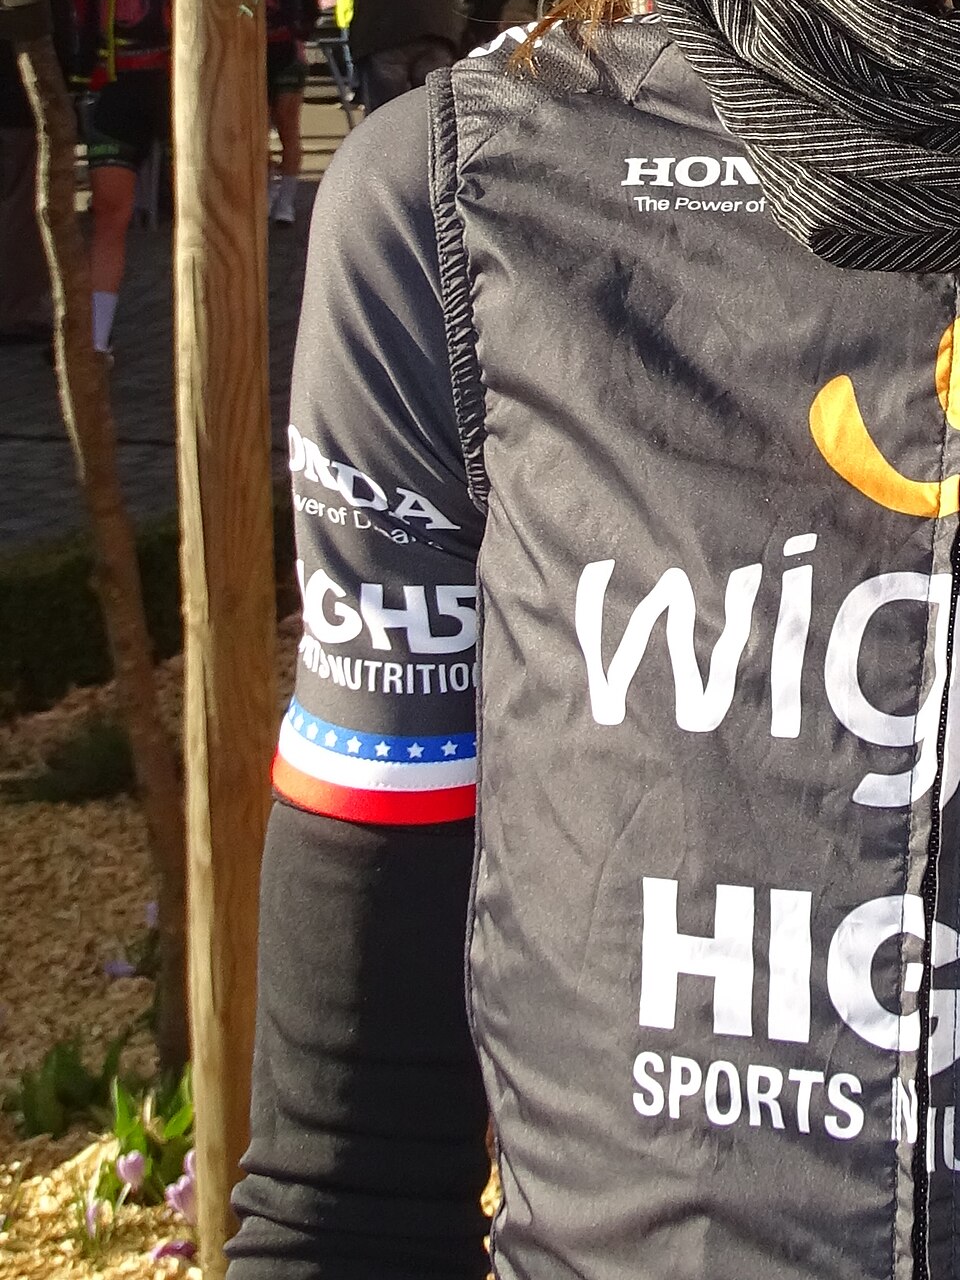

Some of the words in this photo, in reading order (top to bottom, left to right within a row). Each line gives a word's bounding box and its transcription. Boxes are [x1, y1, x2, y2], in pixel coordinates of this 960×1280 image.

[621, 156, 762, 187] HON
[633, 196, 670, 212] The
[674, 197, 743, 212] Power
[745, 196, 768, 213] of
[287, 423, 462, 531] ONDA
[327, 507, 348, 526] of
[631, 1050, 864, 1141] SPORTS
